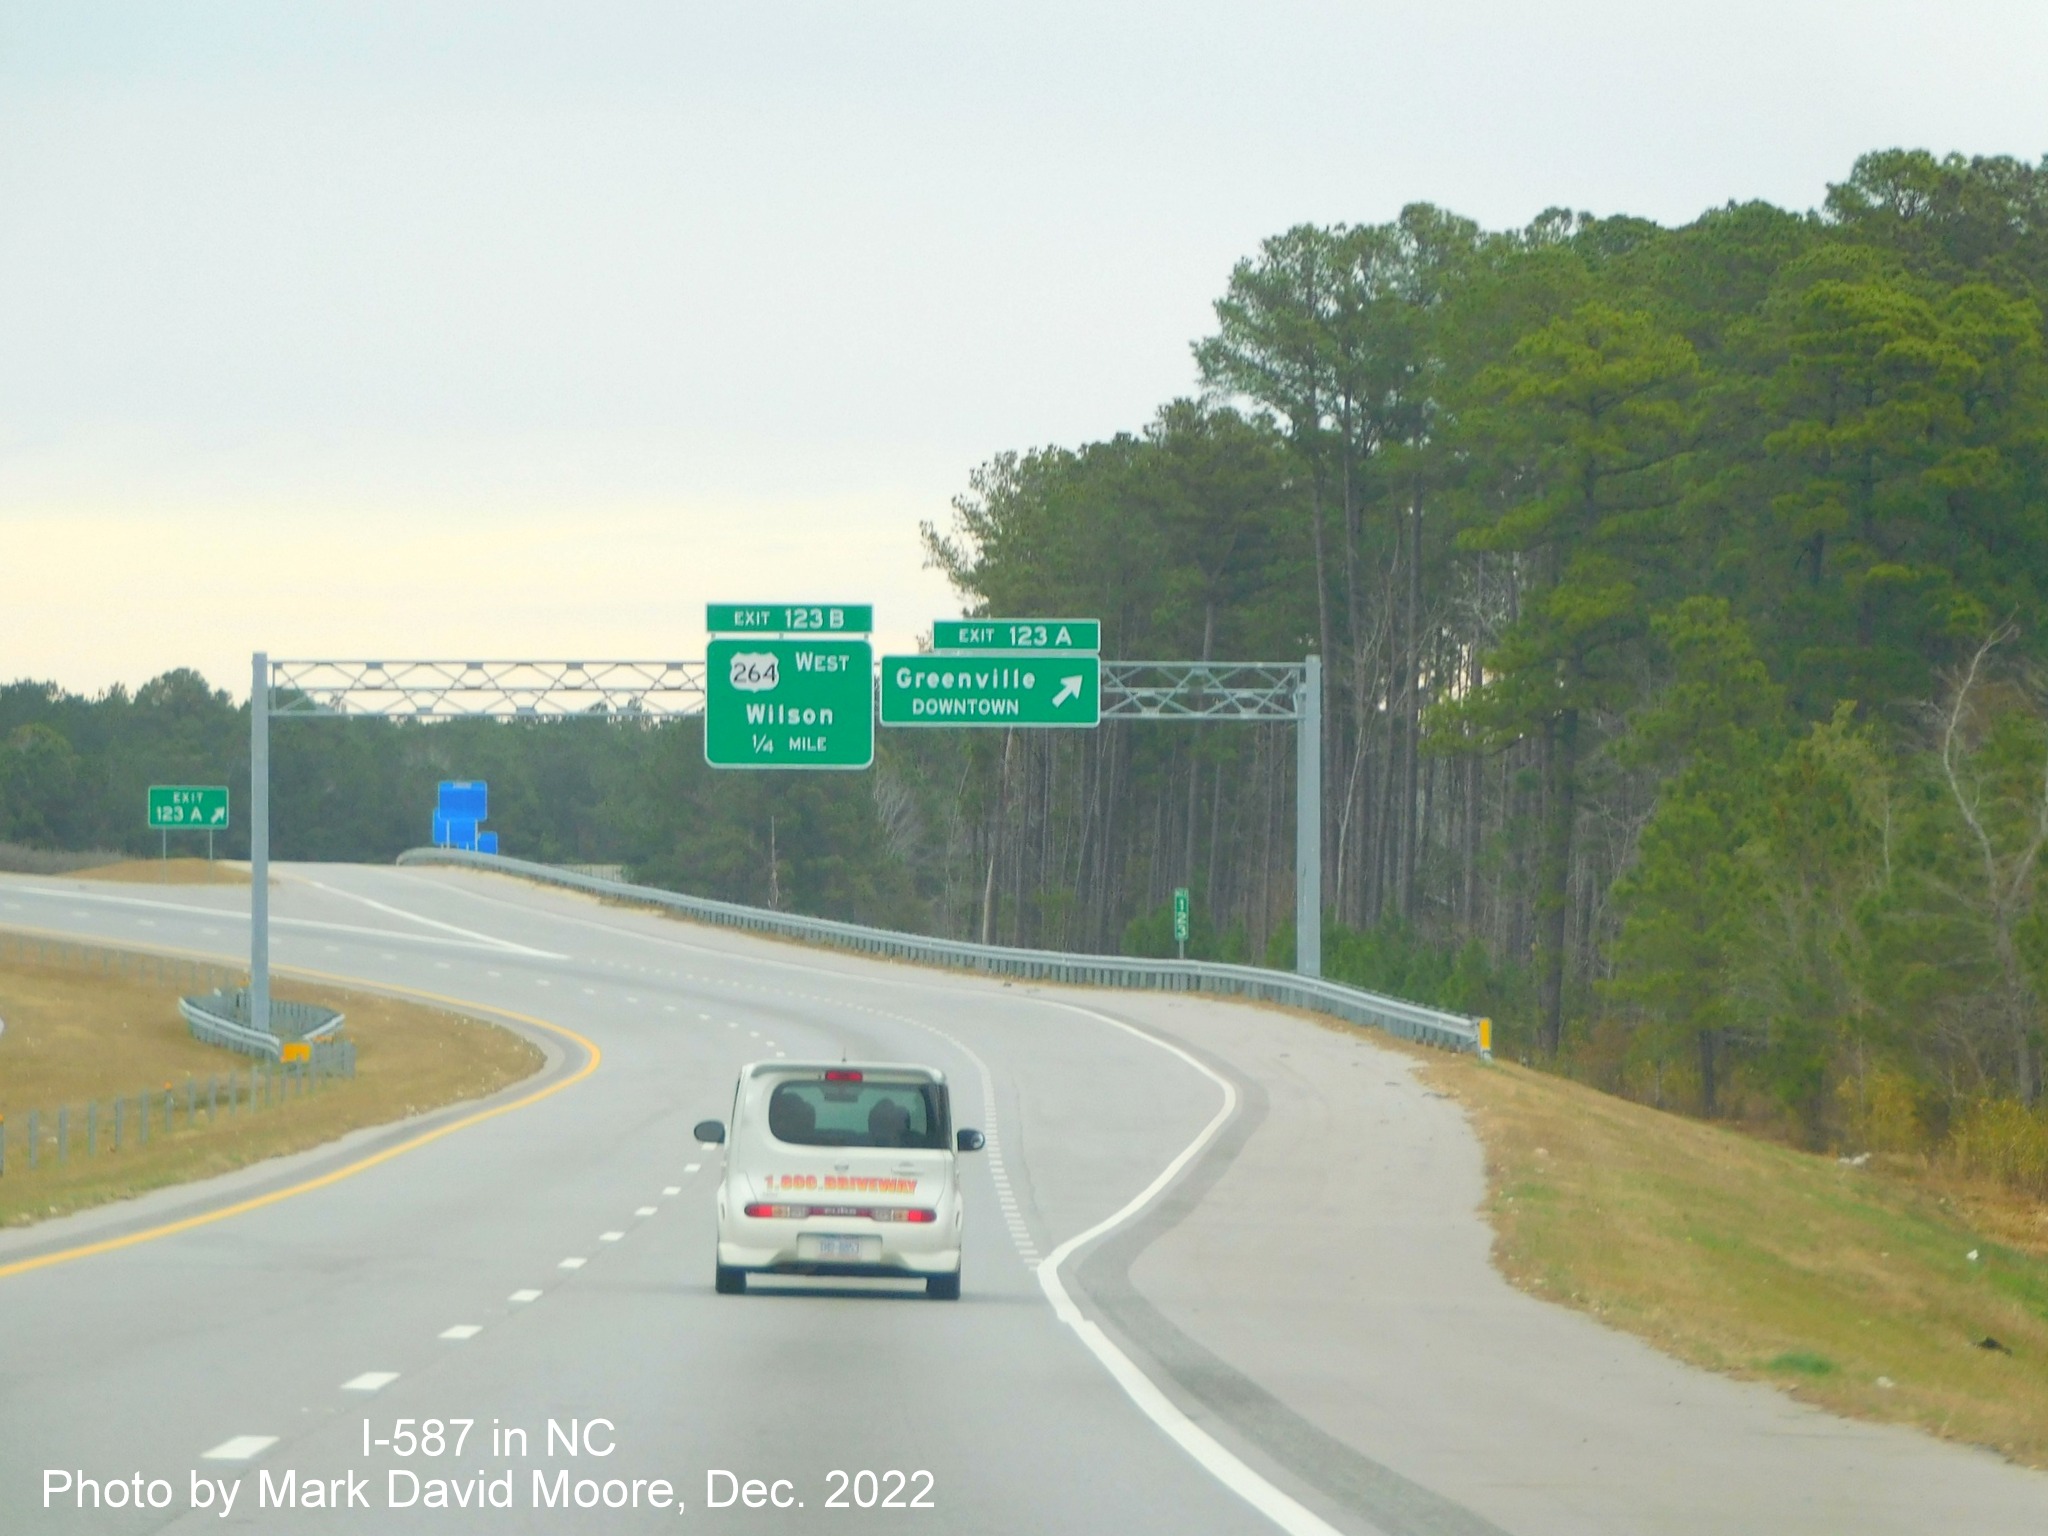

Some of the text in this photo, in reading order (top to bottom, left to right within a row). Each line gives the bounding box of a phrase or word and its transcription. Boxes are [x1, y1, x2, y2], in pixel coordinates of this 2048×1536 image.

[734, 608, 845, 629] EXIT 123 B
[958, 626, 1073, 647] EXIT 123 A
[795, 651, 850, 673] WEST
[732, 661, 779, 685] 264
[895, 667, 1037, 690] Greenville
[745, 703, 834, 726] Wilson
[912, 698, 1019, 716] DOWNTOWN
[788, 736, 827, 753] MILE
[173, 791, 204, 804] EXIT
[155, 806, 203, 822] 123 A
